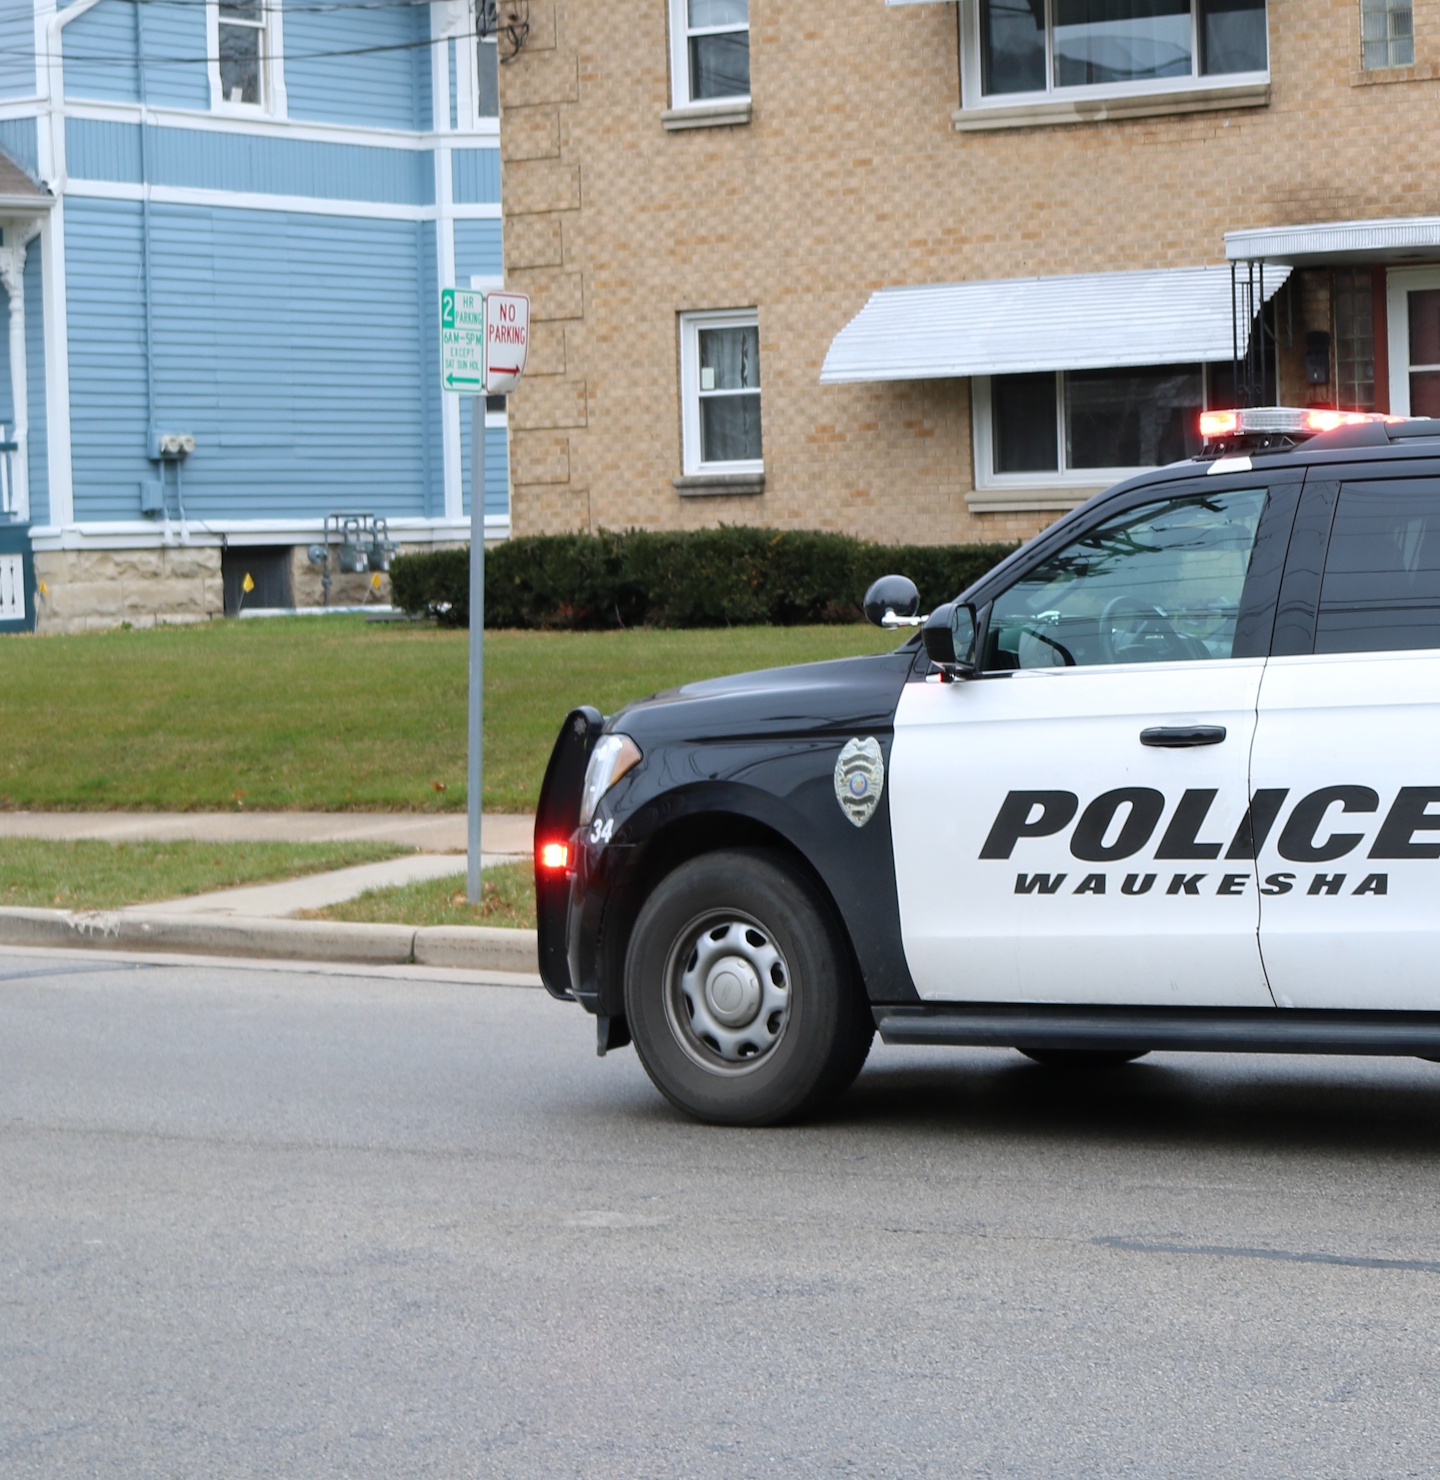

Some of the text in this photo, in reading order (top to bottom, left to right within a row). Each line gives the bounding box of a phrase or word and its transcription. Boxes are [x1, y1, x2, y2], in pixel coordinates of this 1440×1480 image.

[443, 295, 474, 321] 2 HR
[455, 310, 482, 326] PARKING
[500, 303, 516, 322] NO
[489, 324, 526, 345] PARKING
[450, 347, 474, 358] EXCEPT
[445, 359, 480, 371] SAT SUN HOL
[590, 818, 614, 844] 34
[1013, 871, 1389, 896] WAUKESHA
